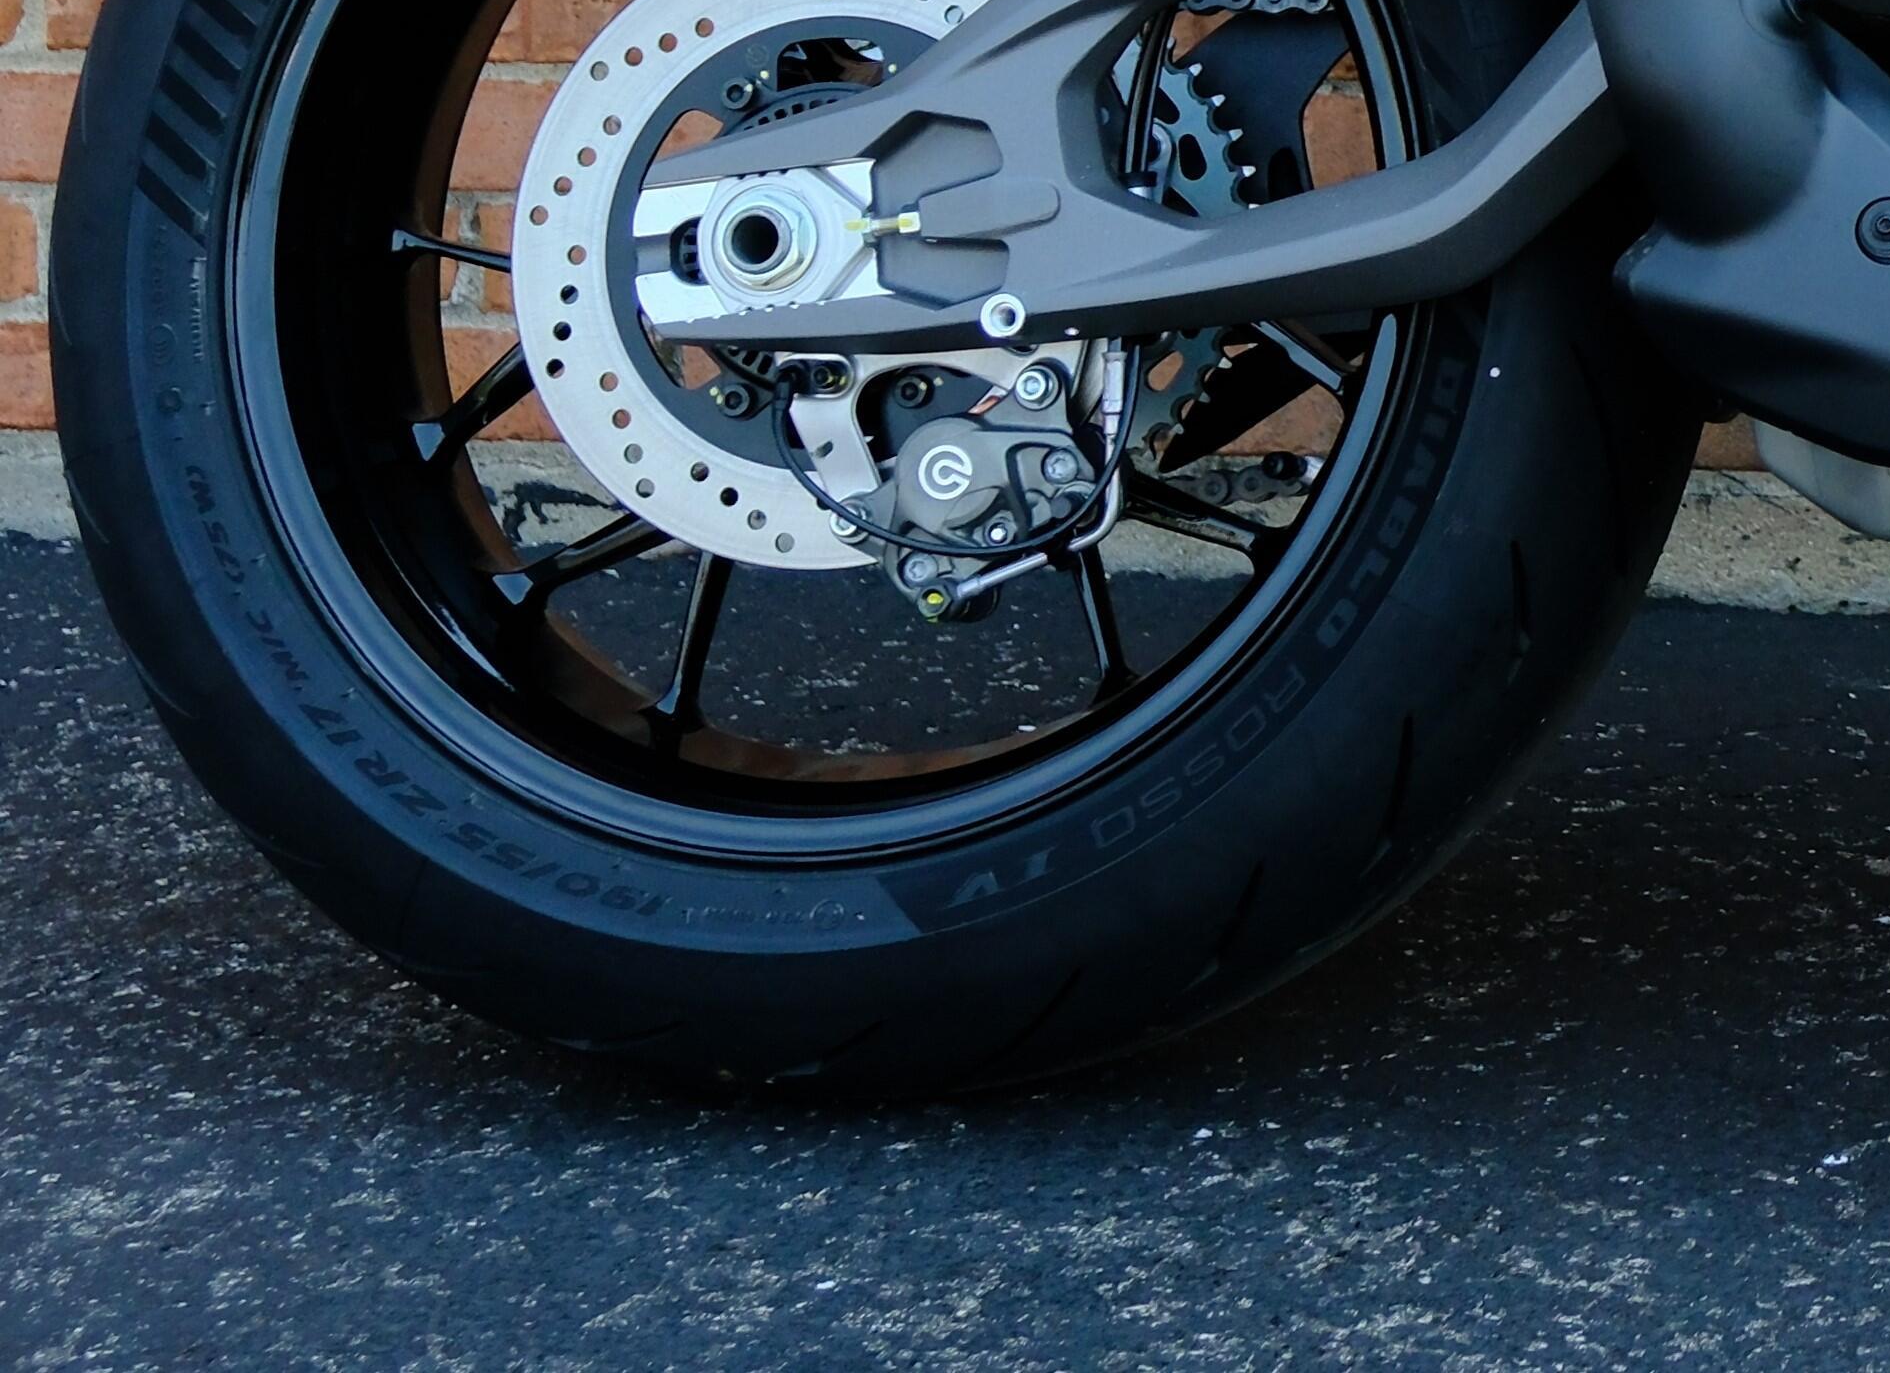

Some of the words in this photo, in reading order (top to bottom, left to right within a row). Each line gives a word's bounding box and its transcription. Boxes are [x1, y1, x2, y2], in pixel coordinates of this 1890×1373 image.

[1317, 358, 1463, 650] DIABLO
[245, 605, 308, 685] M/C
[1090, 664, 1308, 850] ROSSO
[449, 820, 670, 916] 190/55
[946, 849, 1056, 908] IV
